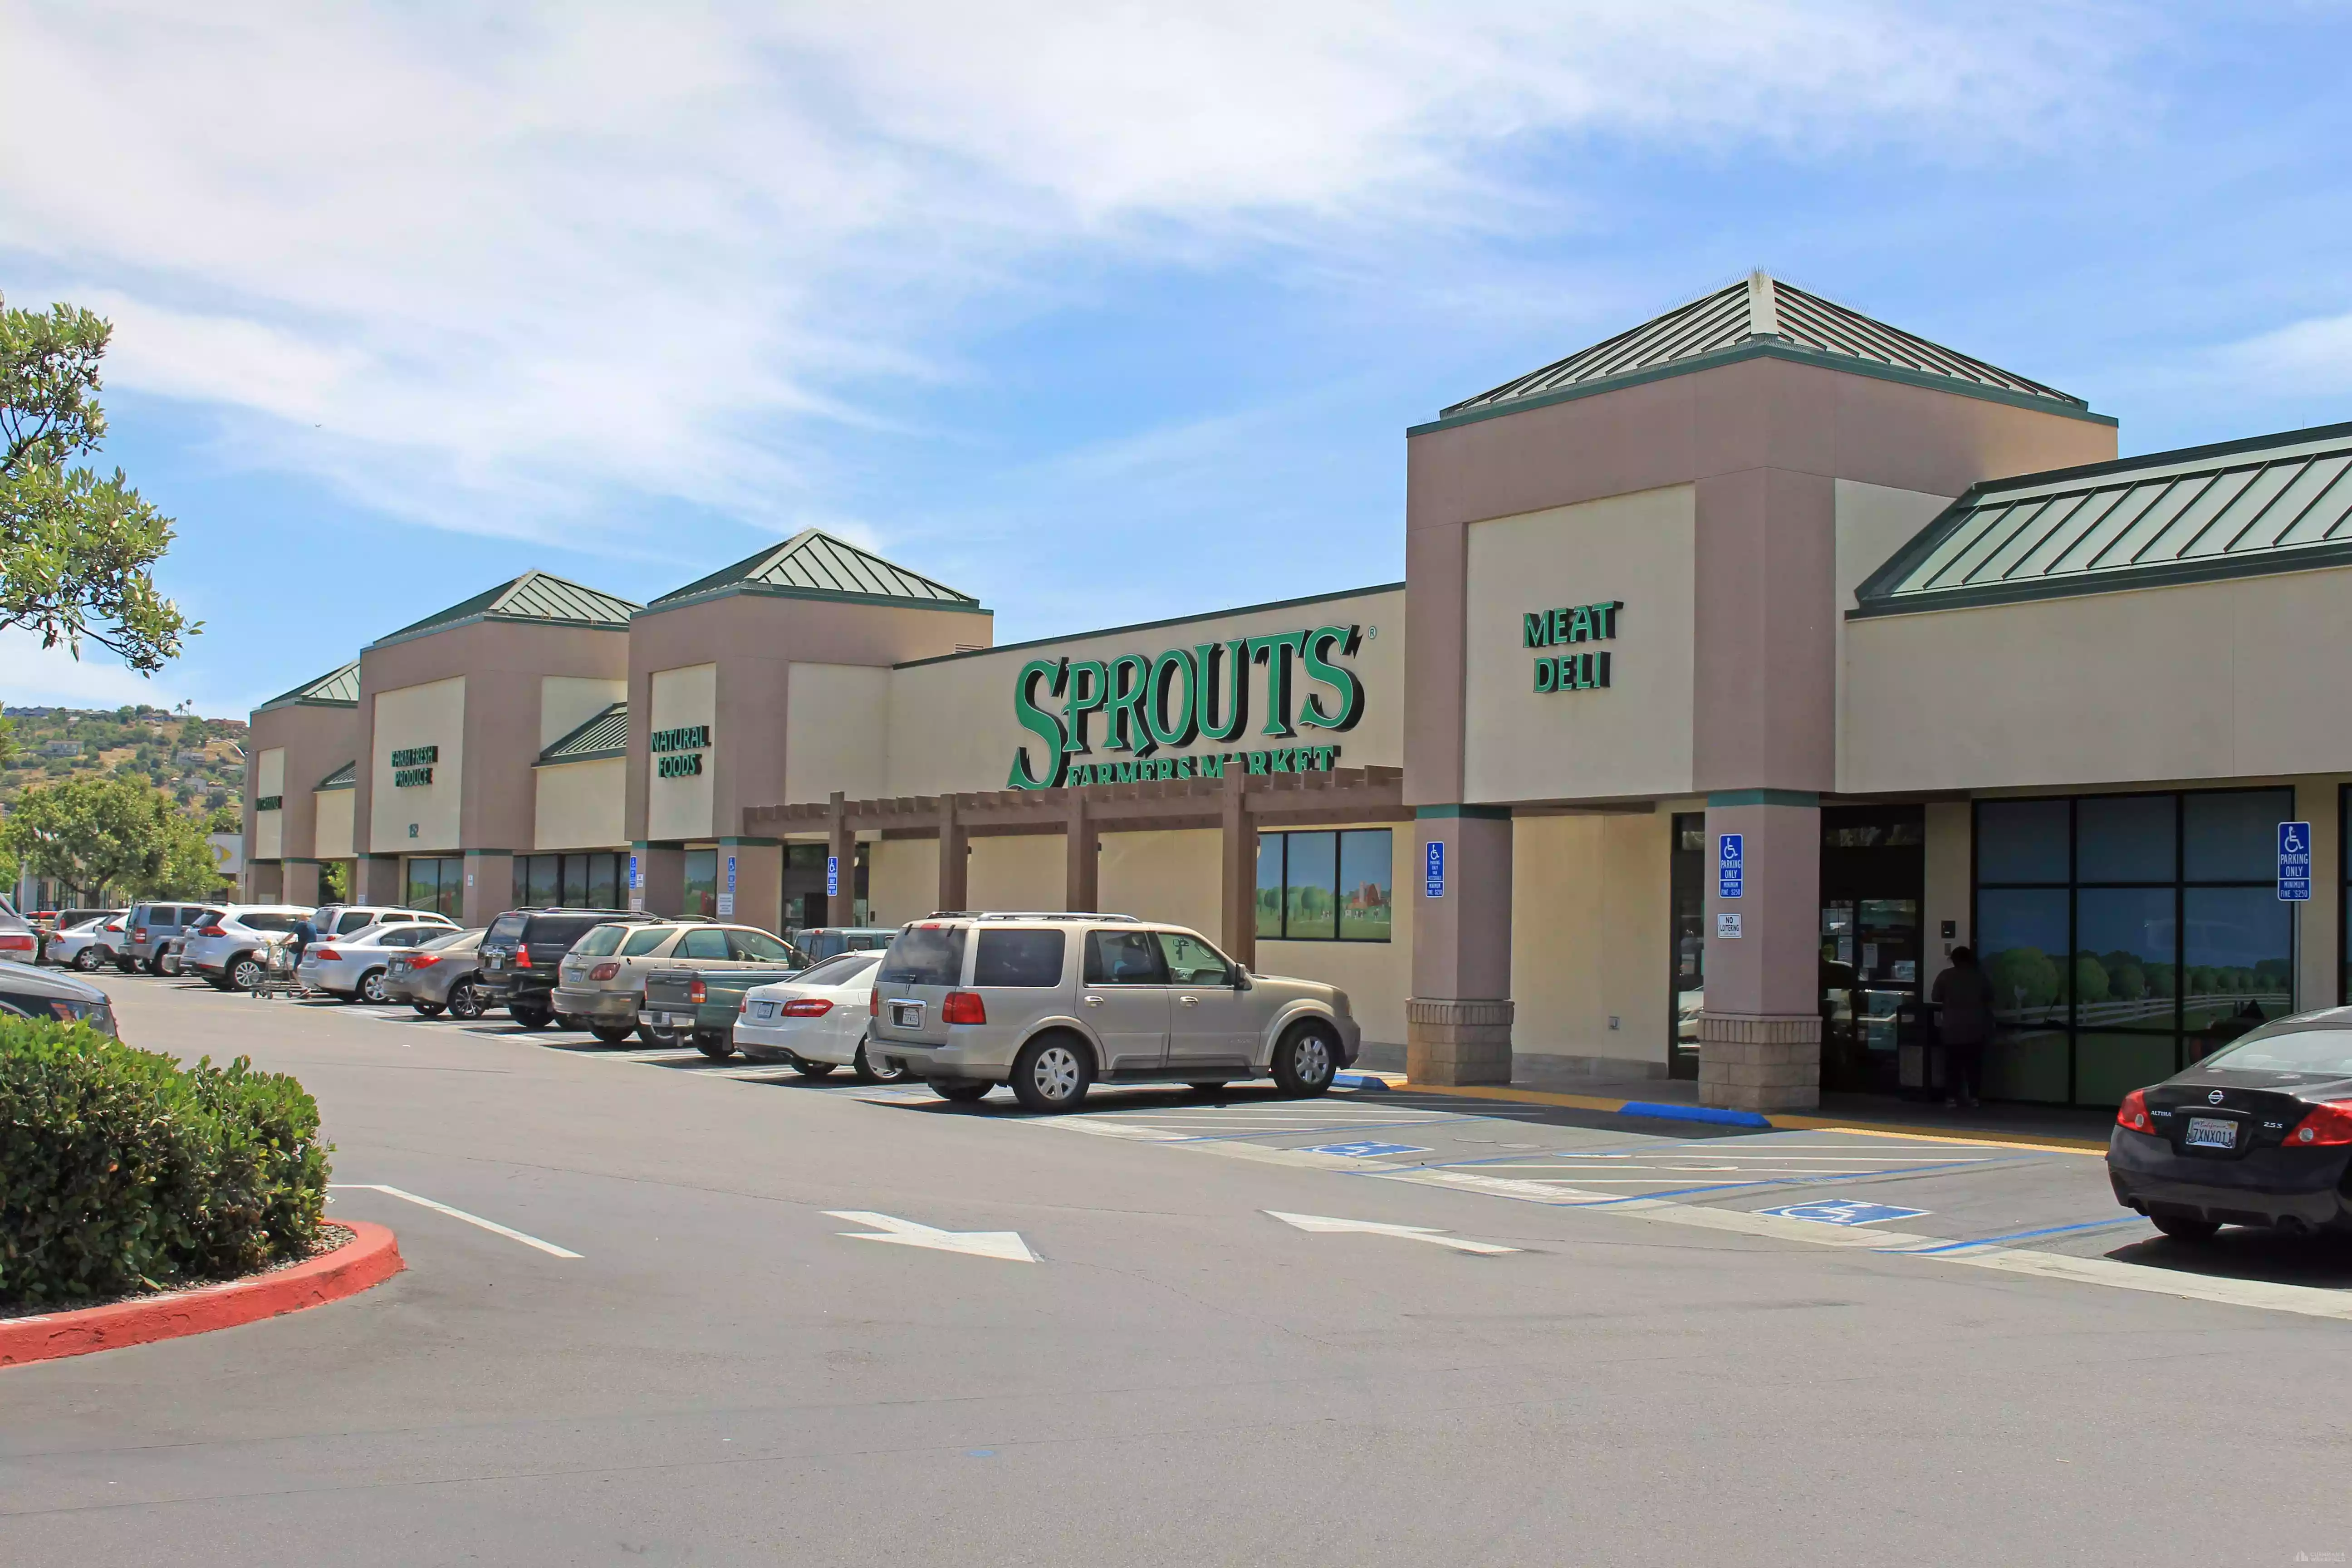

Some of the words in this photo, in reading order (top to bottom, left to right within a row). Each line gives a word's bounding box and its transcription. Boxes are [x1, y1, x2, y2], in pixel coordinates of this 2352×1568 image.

[1523, 600, 1622, 648] MEAT
[1533, 651, 1611, 693] DELI
[1006, 624, 1364, 790] SPROUTS
[650, 725, 711, 752] NATURAL
[392, 750, 412, 767] FARM
[412, 745, 438, 765] FRESH
[658, 753, 702, 778] FOODS
[395, 768, 433, 787] PRODUCE
[1067, 756, 1198, 787] FARMERS
[1721, 860, 1741, 869] PARKING
[2280, 853, 2308, 864] PARKING
[1725, 869, 1738, 878] ONLY
[2286, 866, 2303, 877] ONLY
